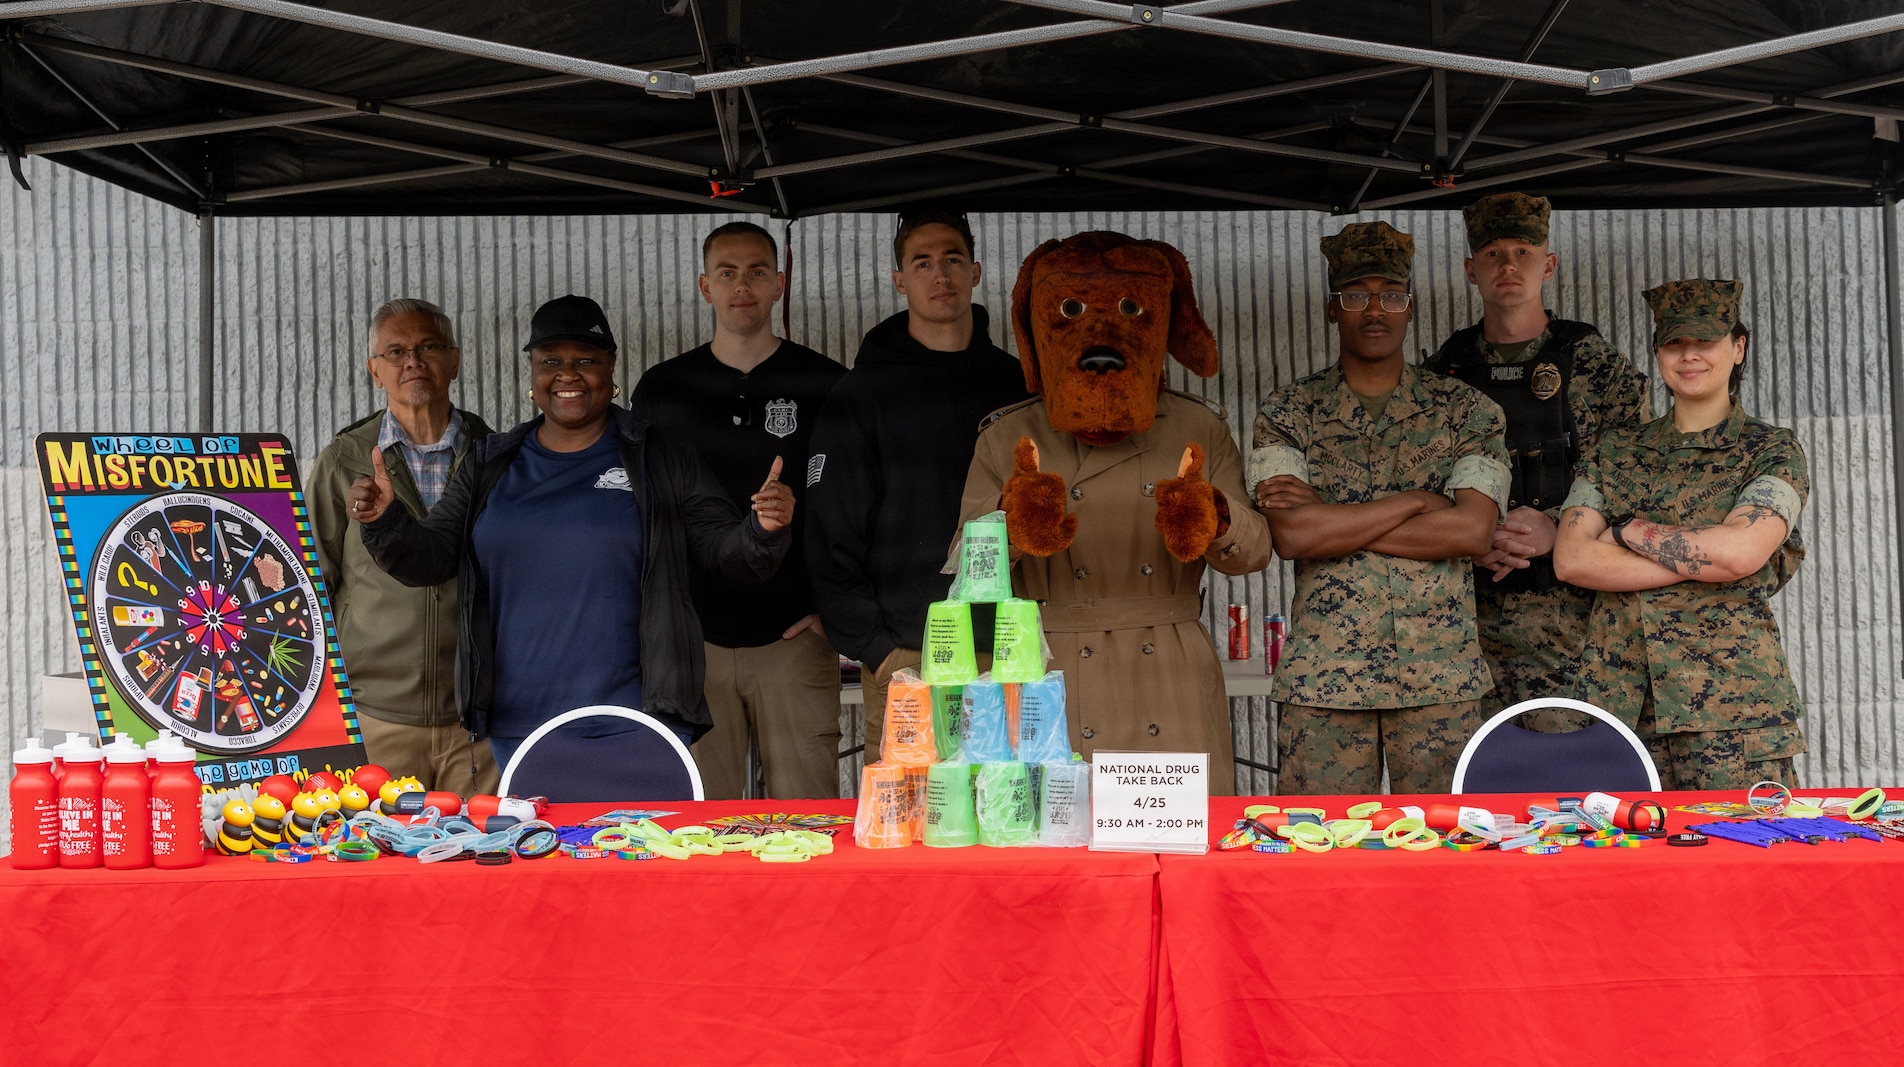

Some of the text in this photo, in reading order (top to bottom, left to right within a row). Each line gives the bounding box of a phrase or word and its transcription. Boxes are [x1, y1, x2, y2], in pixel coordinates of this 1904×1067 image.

[1491, 366, 1524, 380] POLICE
[1411, 439, 1446, 469] MARINES
[46, 441, 293, 492] MISFORTUNE
[1320, 451, 1365, 478] MCCLARTY
[1699, 475, 1738, 503] MARINES
[162, 496, 211, 506] HALLUCINOGENS
[124, 506, 150, 528] STEROIDS
[230, 506, 256, 524] COCAINE
[98, 544, 115, 582] WILD CARD!
[265, 530, 308, 585] METHAMPHETAMINE
[186, 586, 196, 596] 9
[198, 580, 210, 591] 10
[218, 584, 225, 595] 11
[178, 599, 188, 609] 8
[229, 594, 240, 608] 12
[306, 594, 322, 636] STIMULANTS
[97, 606, 112, 646] INHALANTS
[177, 618, 188, 626] 7
[186, 633, 196, 644] 6
[236, 630, 248, 640] 2
[201, 644, 210, 656] 5
[230, 642, 240, 652] 3
[216, 648, 225, 659] 4
[307, 655, 322, 692] MARIJUANA
[122, 674, 144, 701] OPIOIDS
[272, 702, 305, 735] DEPRESSANTS
[170, 719, 198, 738] ALCOHOL
[228, 736, 257, 746] TOBACCO
[200, 766, 222, 782] he
[1100, 765, 1200, 774] NATIONAL DRUG
[1116, 776, 1184, 785] TAKE BACK
[1134, 796, 1166, 810] 4/25
[59, 810, 80, 819] LIEVE
[82, 810, 93, 820] IN
[112, 811, 122, 820] IN
[162, 811, 172, 820] IN
[62, 820, 80, 831] ME
[1096, 819, 1122, 828] 9:30
[1126, 819, 1144, 828] AM
[1156, 819, 1182, 828] 2:00
[1187, 819, 1204, 828] PM
[70, 830, 94, 839] healthy
[71, 840, 91, 850] FREE
